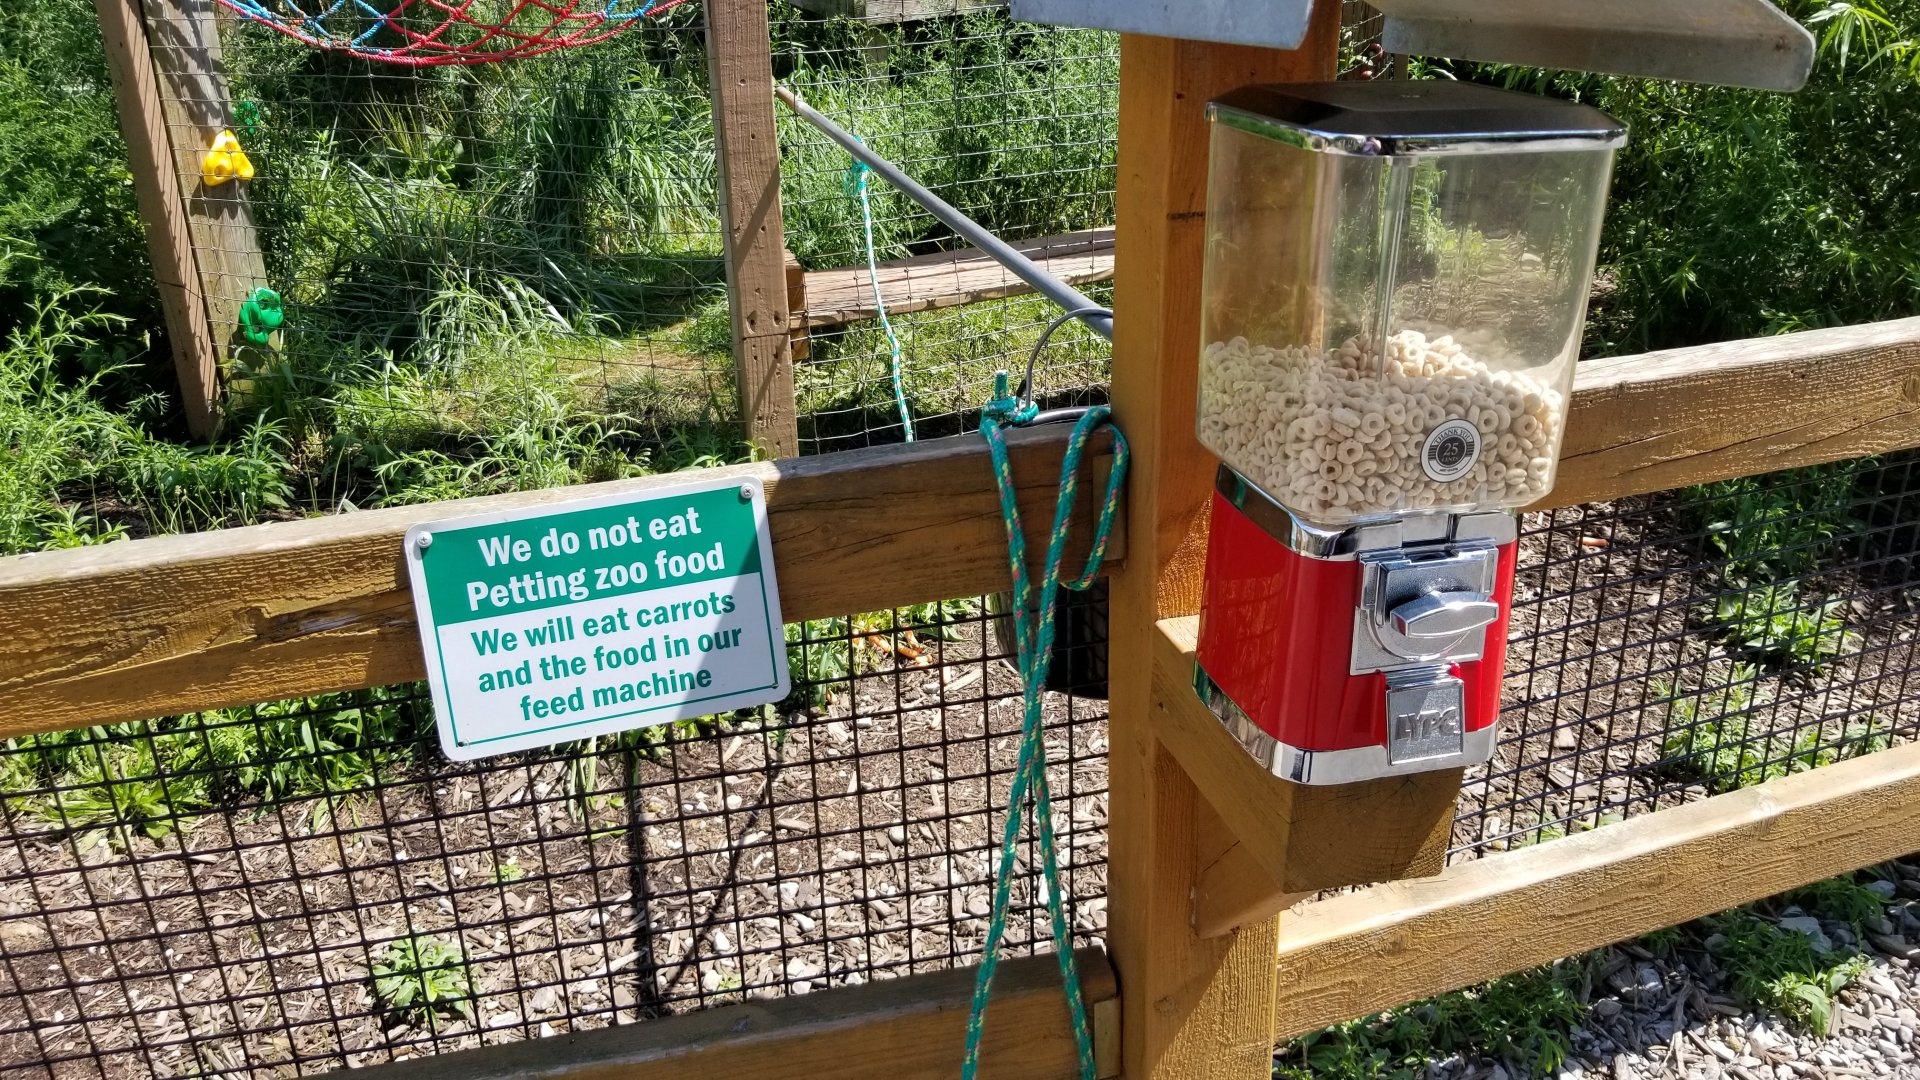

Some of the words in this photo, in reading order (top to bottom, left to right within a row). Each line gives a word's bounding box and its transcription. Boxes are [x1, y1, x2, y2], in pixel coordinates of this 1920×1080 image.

[1434, 429, 1459, 445] THANK
[1460, 430, 1472, 442] YOU
[1443, 443, 1459, 456] 25
[478, 535, 532, 567] We
[541, 527, 580, 558] do
[588, 516, 640, 550] not
[650, 507, 702, 540] eat
[466, 567, 589, 611] Petting
[594, 561, 648, 590] zoo
[654, 542, 725, 579] food
[471, 628, 518, 656] We
[524, 616, 574, 649] will
[583, 608, 630, 637] eat
[637, 591, 736, 628] carrots
[478, 660, 532, 693] and
[539, 649, 587, 681] the
[594, 638, 657, 671] food
[664, 634, 690, 659] in
[697, 626, 743, 653] our
[520, 687, 585, 721] feed
[593, 668, 713, 708] machine
